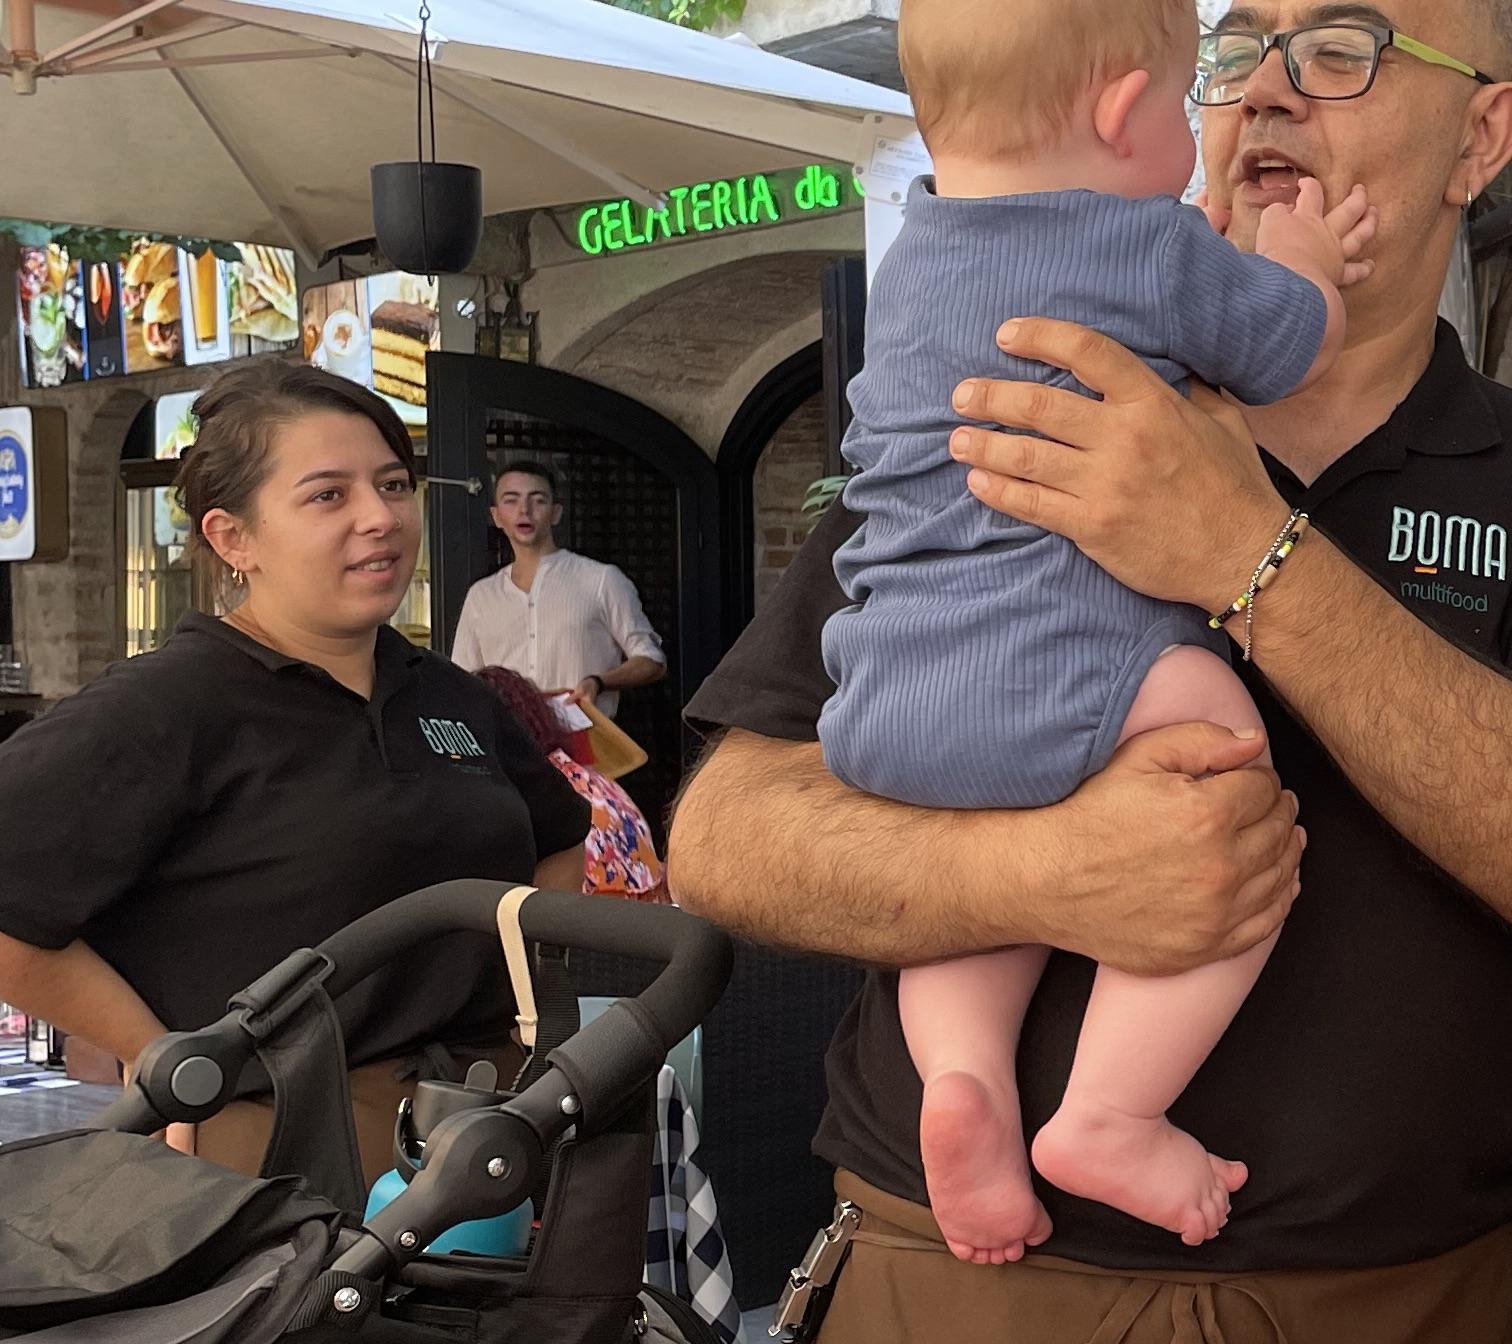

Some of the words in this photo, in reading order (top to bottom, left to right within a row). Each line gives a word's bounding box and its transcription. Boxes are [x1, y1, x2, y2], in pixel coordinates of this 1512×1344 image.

[579, 175, 779, 255] GELATERIA
[1388, 506, 1507, 581] BOMA
[1400, 580, 1488, 613] multifood
[418, 716, 486, 757] BOMA
